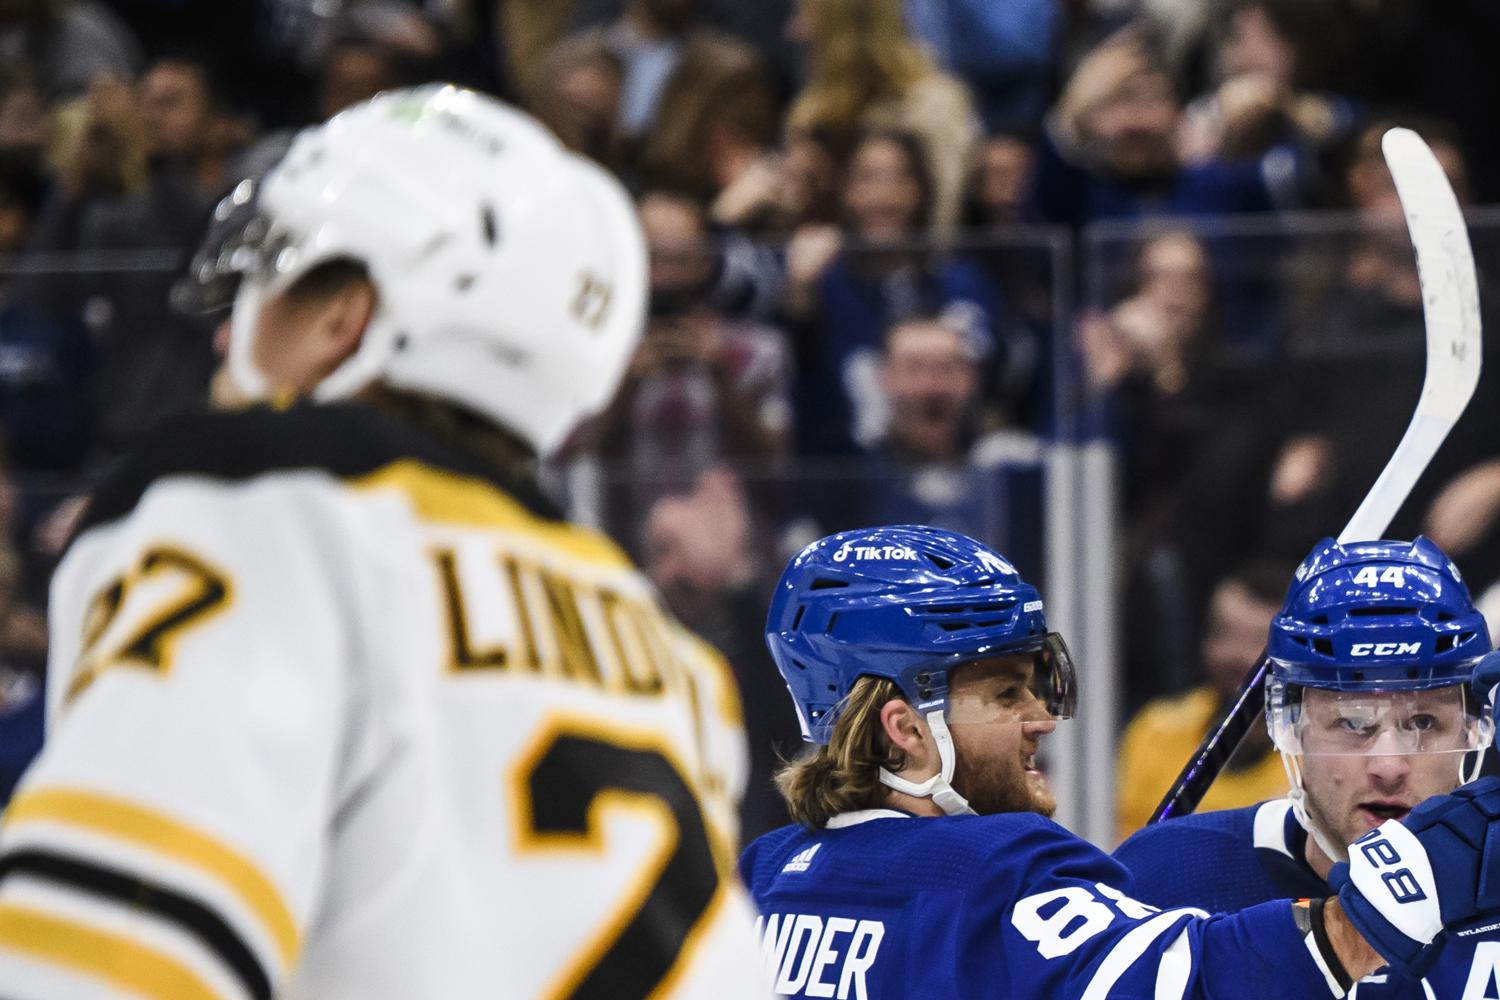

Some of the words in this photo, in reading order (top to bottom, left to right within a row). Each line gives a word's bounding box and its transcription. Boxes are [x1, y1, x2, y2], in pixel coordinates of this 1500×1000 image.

[855, 546, 918, 561] TikTok
[1353, 566, 1405, 588] 44
[1350, 642, 1422, 657] CCM
